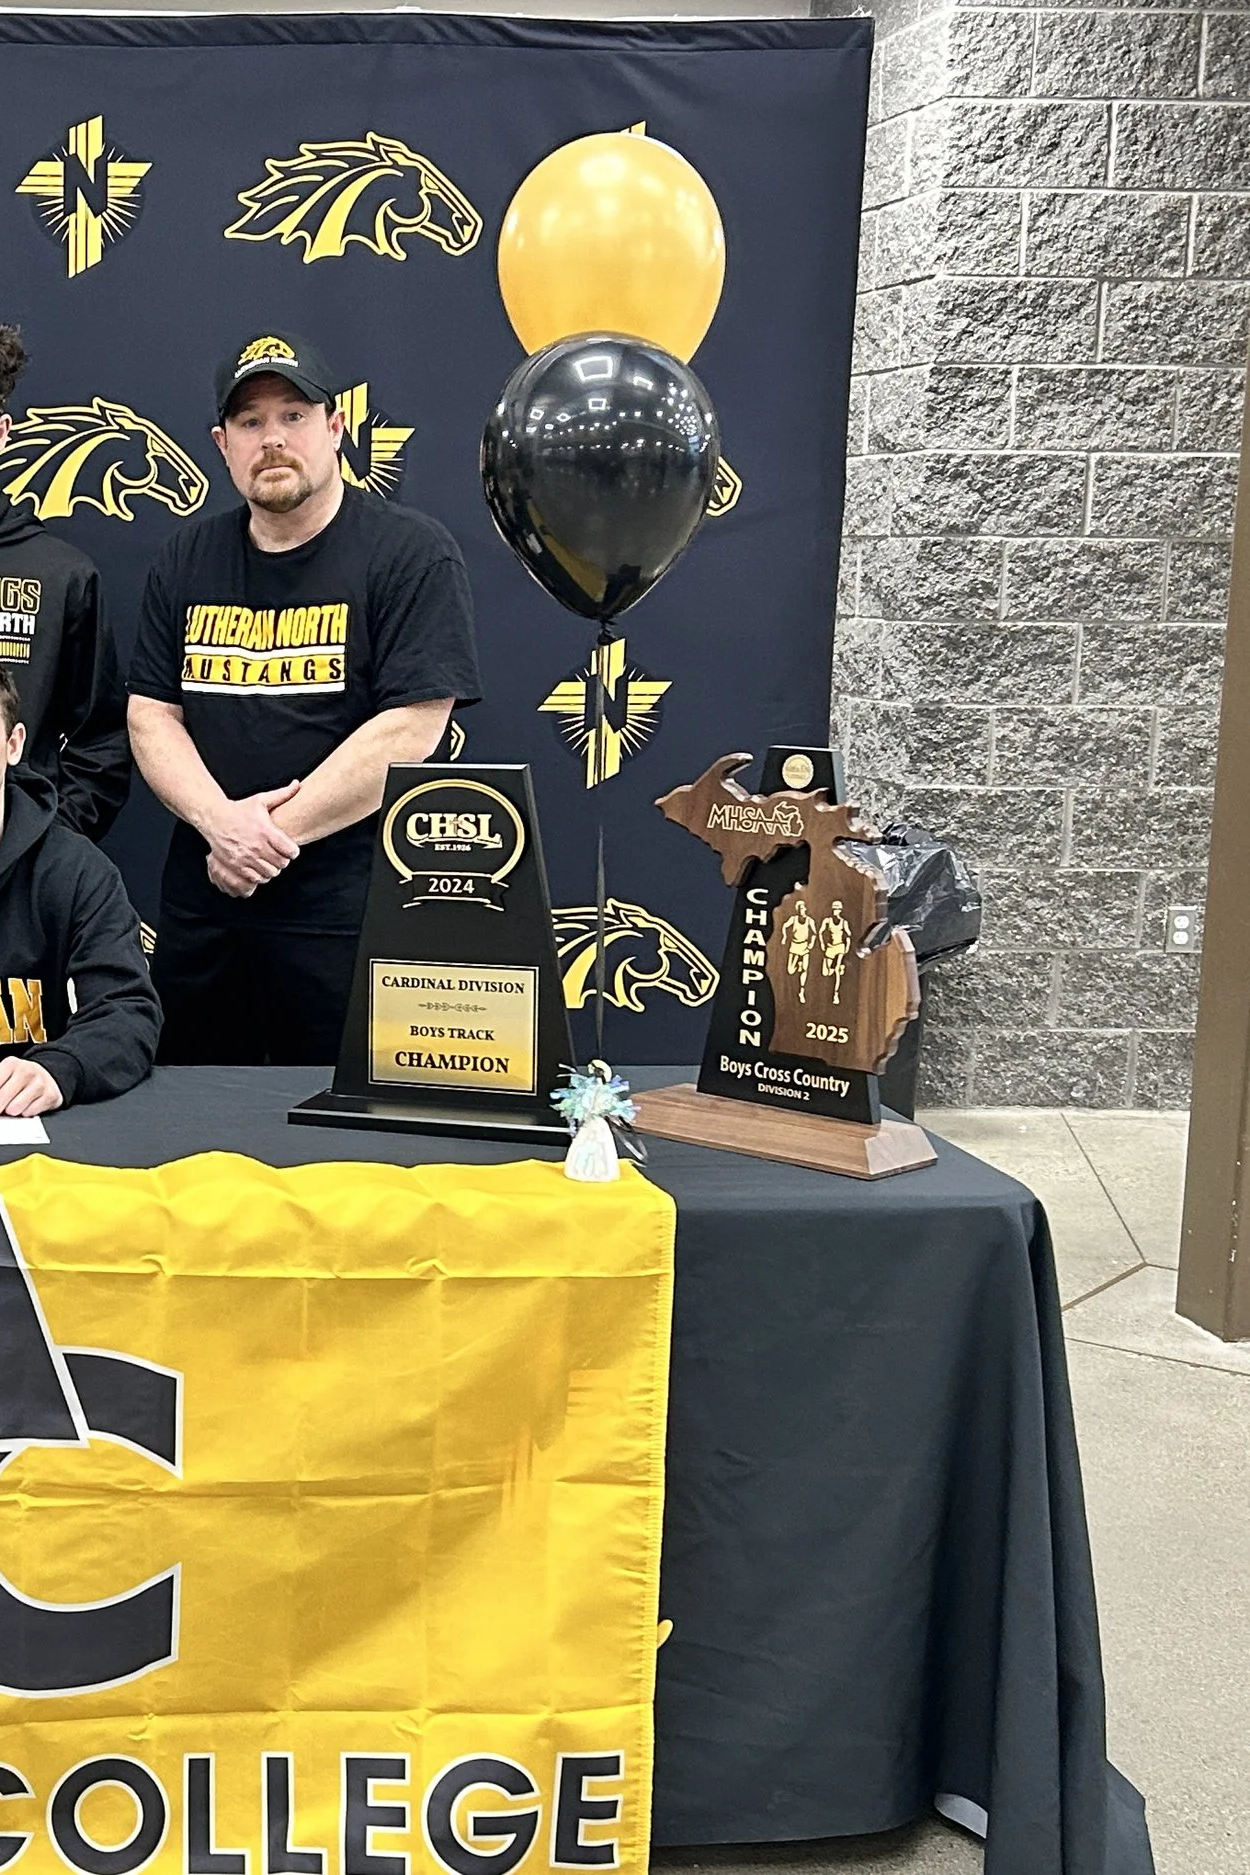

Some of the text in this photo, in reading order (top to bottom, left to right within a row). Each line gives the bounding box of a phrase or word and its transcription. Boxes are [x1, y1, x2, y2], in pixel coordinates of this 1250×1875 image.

[63, 153, 109, 219] N
[184, 602, 349, 651] LUTHERAN NORTH
[183, 656, 343, 684] MUSTANGS
[406, 812, 502, 844] CHSL
[428, 877, 475, 894] 2024
[738, 888, 769, 1048] CHAMPION
[381, 975, 526, 994] CARDINAL DIVISION
[409, 1025, 496, 1042] BOYS TRACK
[805, 1022, 850, 1044] 2025
[394, 1050, 511, 1074] CHAMPION
[719, 1054, 851, 1098] Boys Cross Country
[757, 1082, 811, 1101] DIVISION 2
